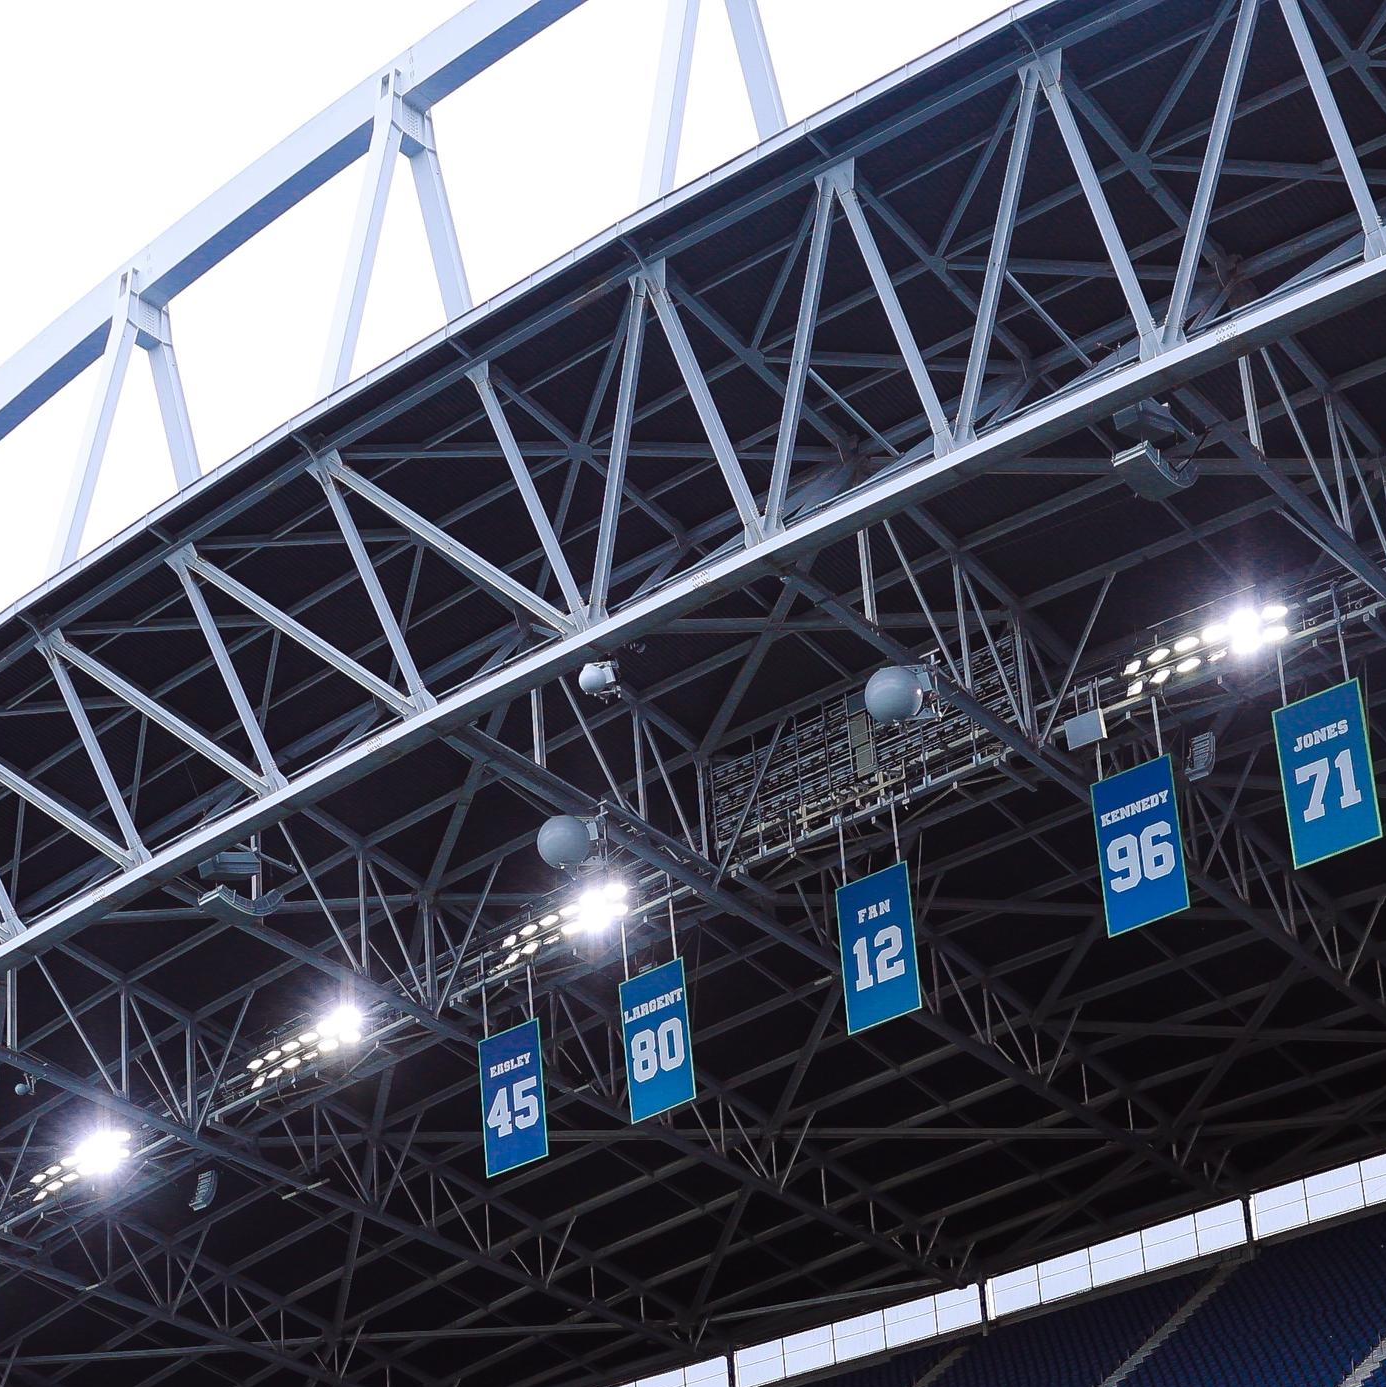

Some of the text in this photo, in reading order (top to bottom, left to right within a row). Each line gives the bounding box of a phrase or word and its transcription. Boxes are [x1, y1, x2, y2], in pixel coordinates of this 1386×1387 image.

[1293, 719, 1349, 753] JONES
[1100, 789, 1169, 828] KENNEDY
[1295, 748, 1362, 823] 71
[1106, 820, 1176, 893] 96
[857, 898, 891, 924] FAN
[852, 924, 906, 992] 12
[623, 987, 683, 1025] LARGENT
[489, 1052, 531, 1078] EASLEY
[630, 1017, 685, 1083] 80
[486, 1075, 540, 1138] 45
